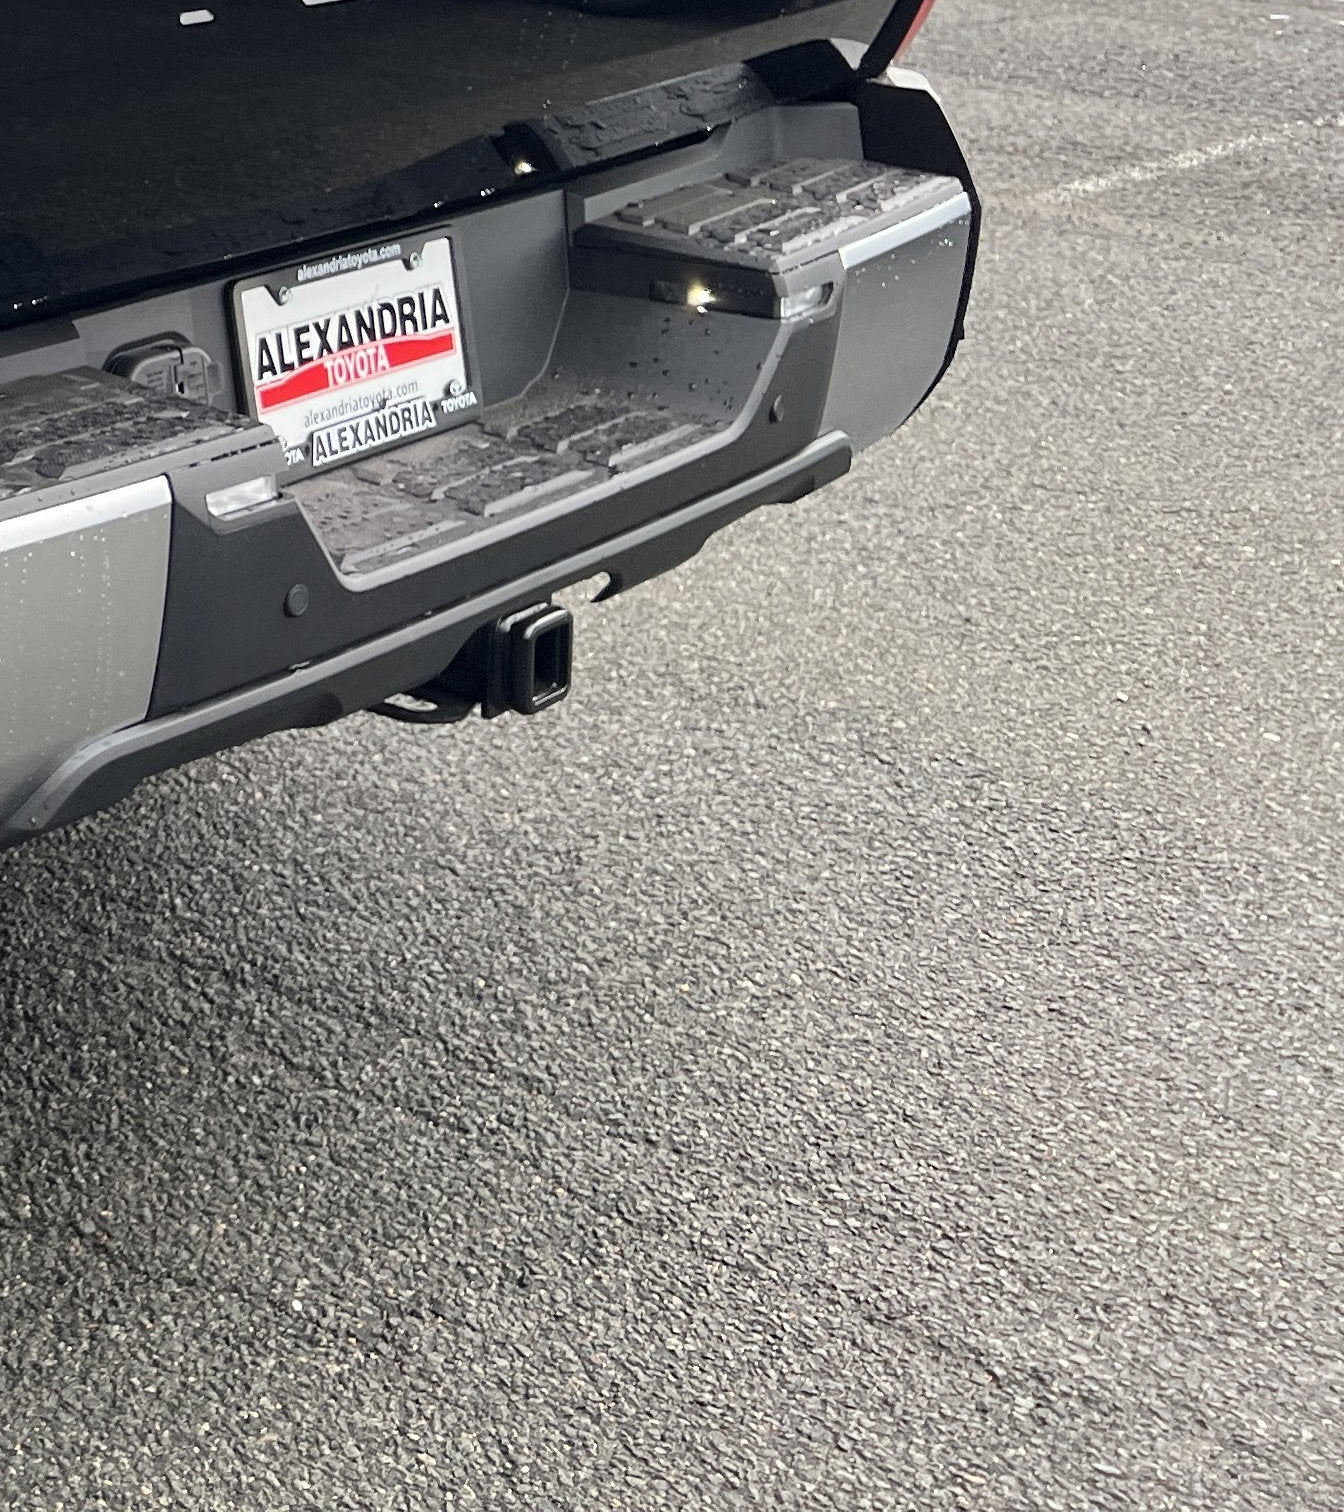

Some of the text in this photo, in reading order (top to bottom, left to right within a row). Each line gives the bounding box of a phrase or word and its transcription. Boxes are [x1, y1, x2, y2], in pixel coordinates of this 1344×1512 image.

[297, 243, 401, 281] alexandriatoyota.com
[257, 288, 451, 381] ALEXANDRIA
[324, 345, 390, 387] TOYOTA
[304, 381, 418, 428] alexandriatoyota.com
[441, 391, 478, 414] TOYOTA
[315, 401, 433, 462] ALEXANDRIA
